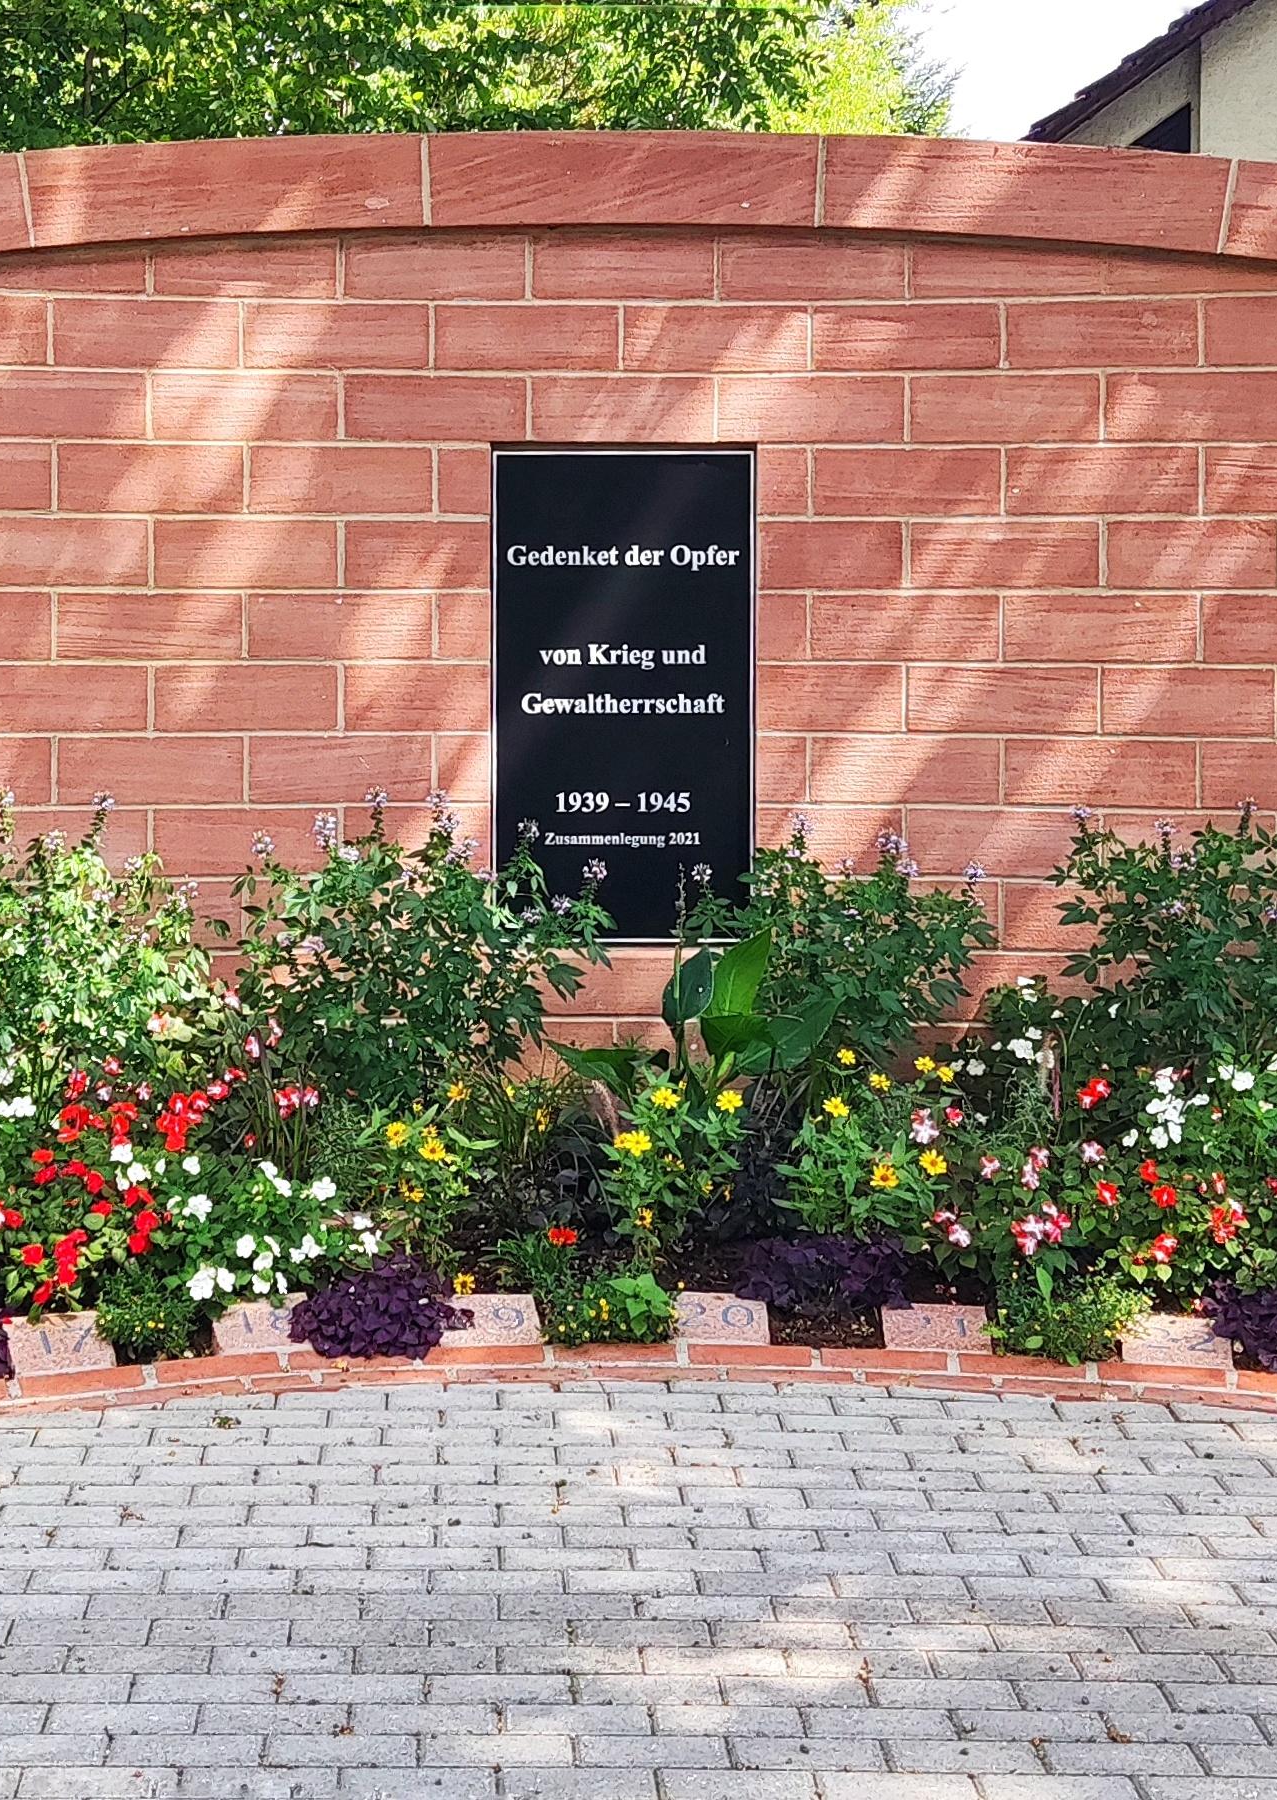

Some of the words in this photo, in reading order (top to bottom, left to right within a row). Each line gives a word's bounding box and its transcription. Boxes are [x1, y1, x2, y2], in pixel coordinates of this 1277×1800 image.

[507, 546, 618, 566] Gedenket
[625, 545, 664, 566] der
[670, 545, 739, 571] Opfer
[539, 649, 582, 665] von
[588, 644, 655, 670] Krieg
[662, 645, 706, 664] und
[522, 693, 725, 714] Gewaltherrschaft
[556, 792, 609, 812] 1939
[638, 792, 690, 812] 1945
[545, 833, 665, 848] Zusammenlegung
[669, 832, 700, 844] 2021
[37, 1324, 97, 1355] 17
